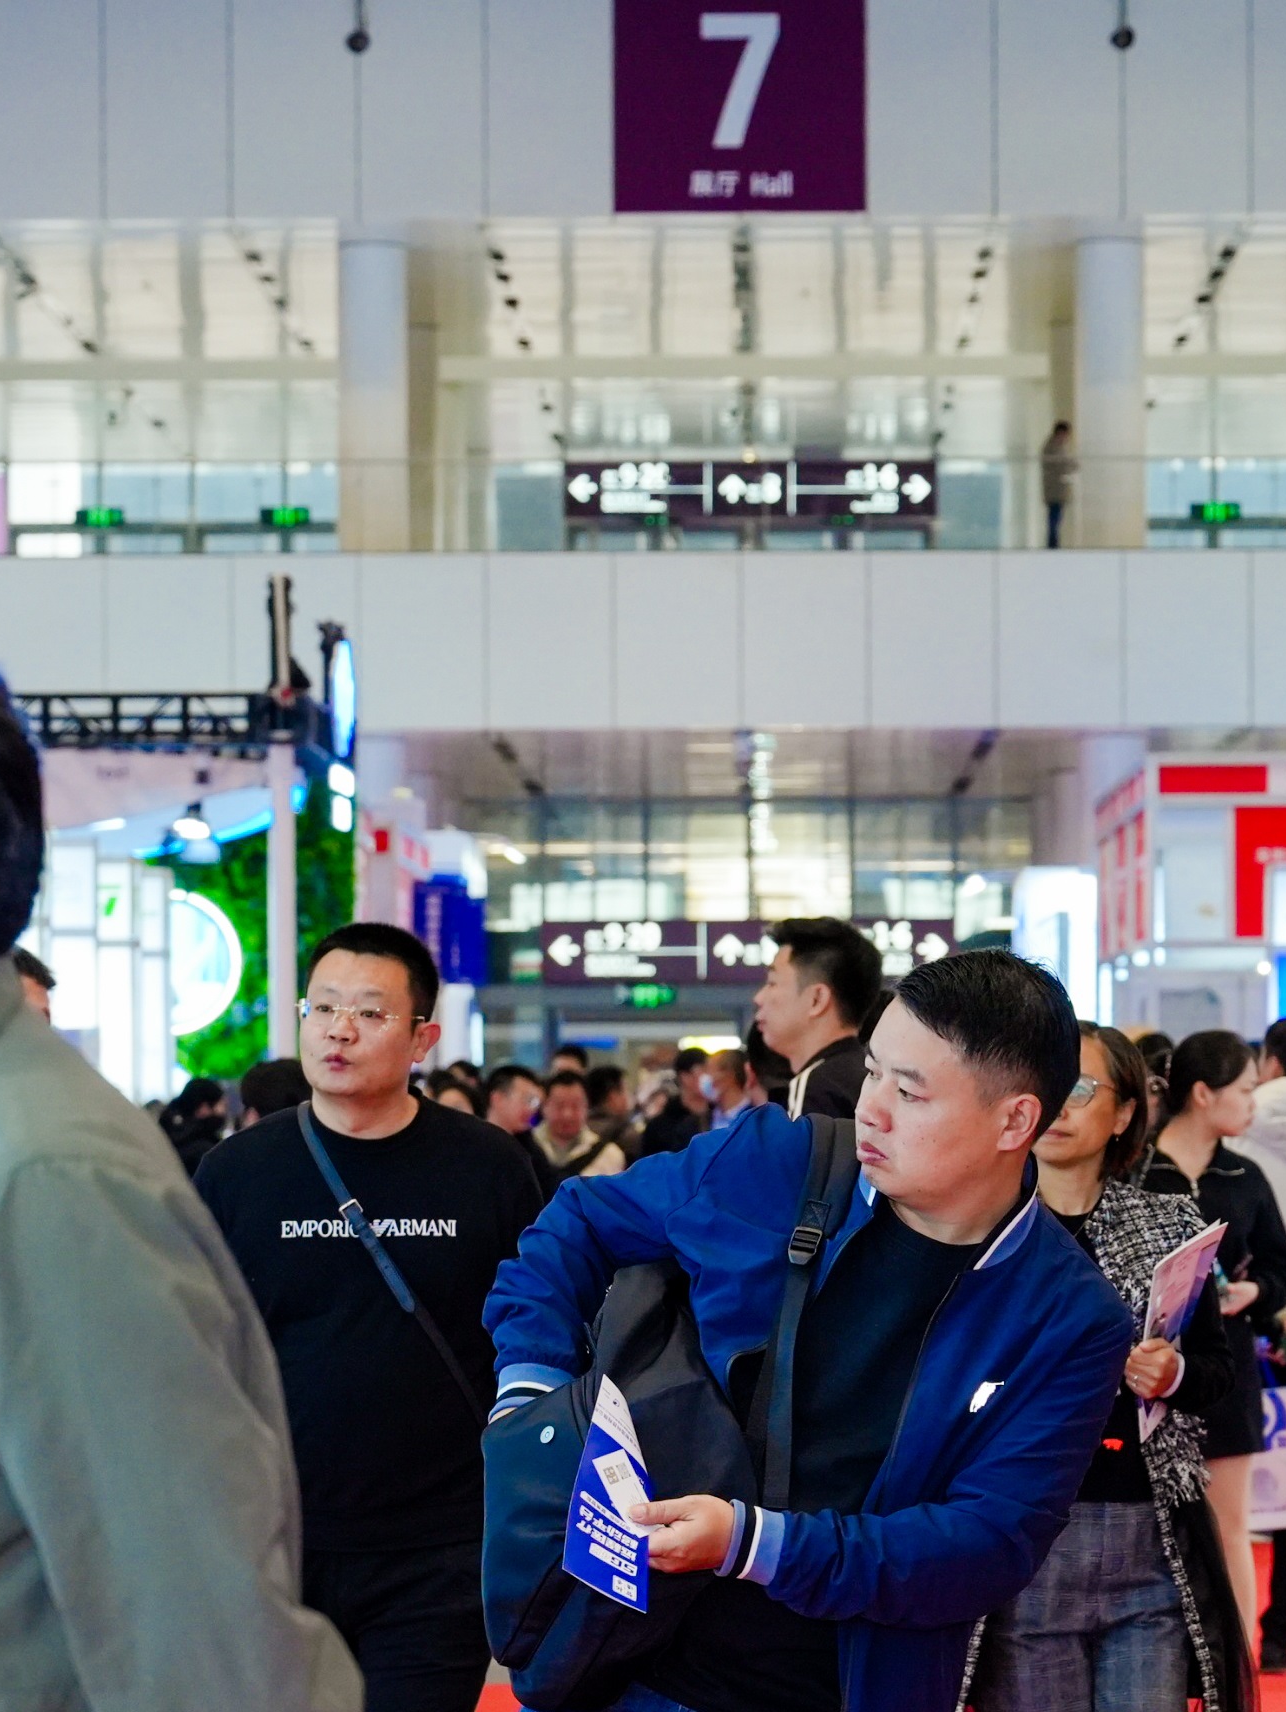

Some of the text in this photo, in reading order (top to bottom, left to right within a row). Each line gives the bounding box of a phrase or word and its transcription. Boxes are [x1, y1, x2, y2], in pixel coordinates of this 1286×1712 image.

[699, 12, 780, 149] 7
[750, 171, 794, 197] Hall
[386, 1219, 457, 1237] ARMANI
